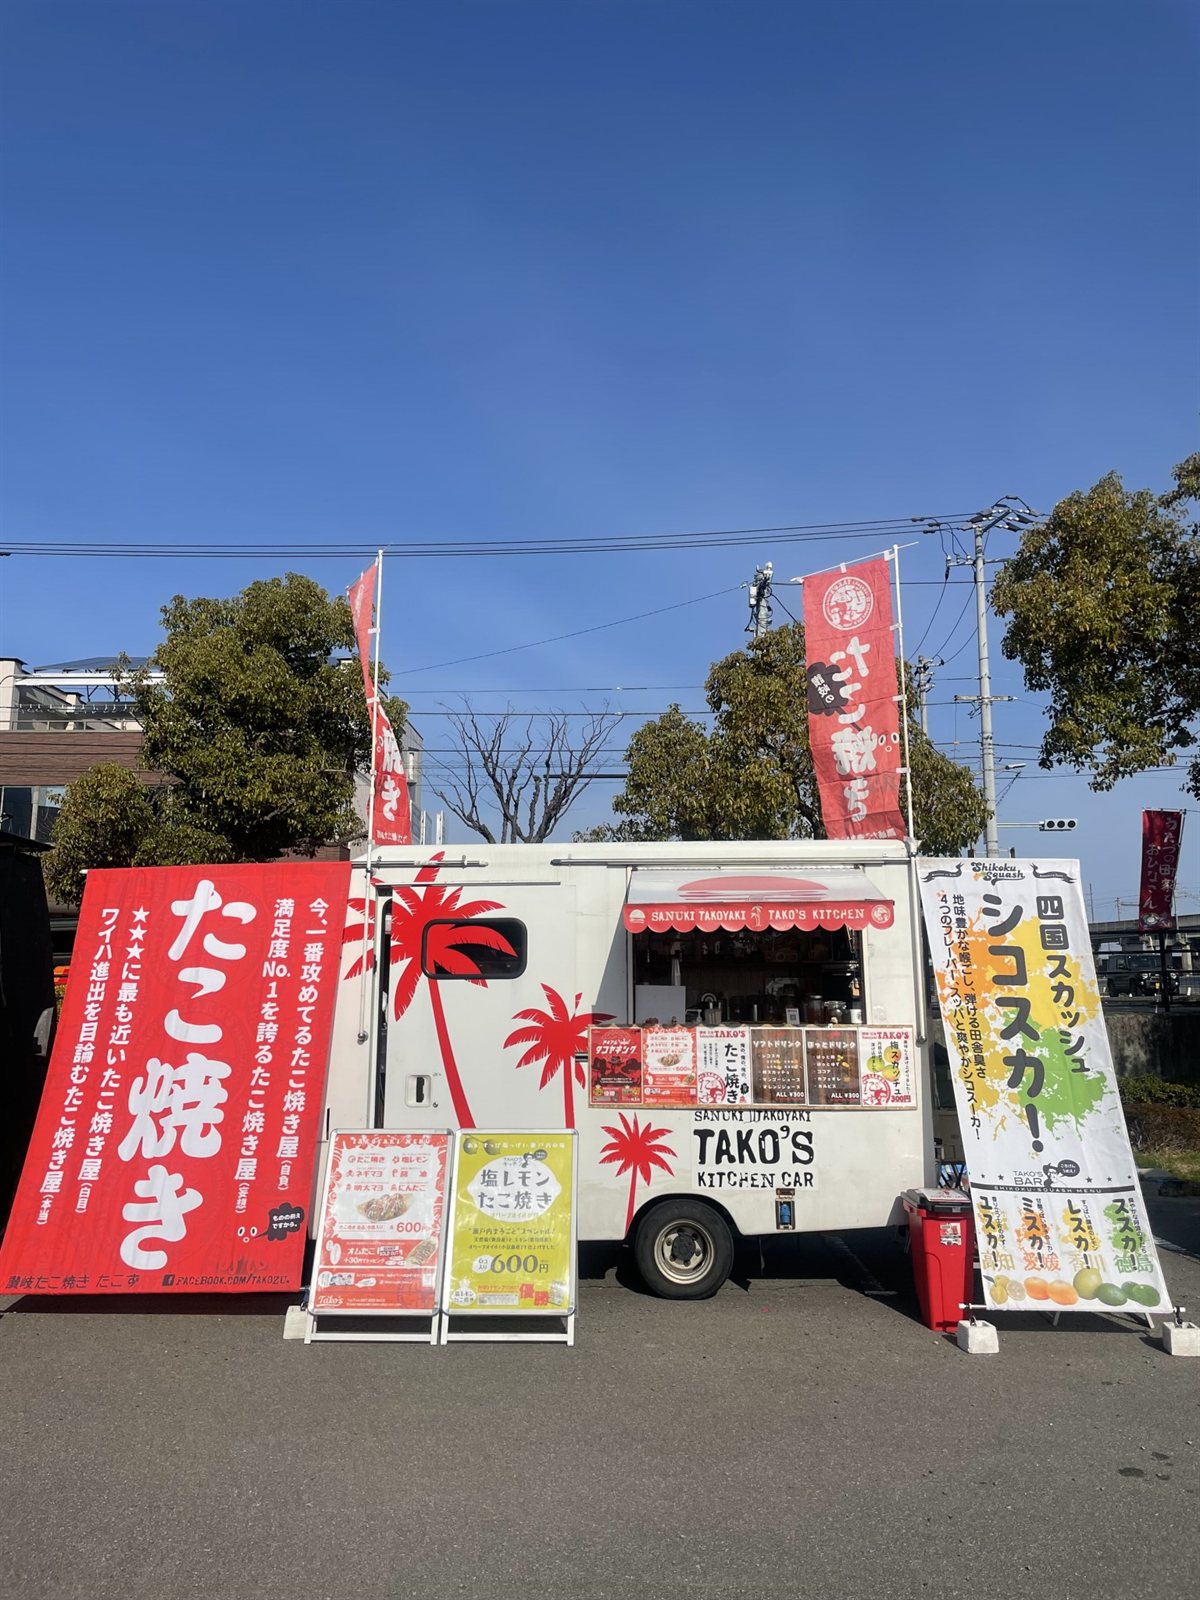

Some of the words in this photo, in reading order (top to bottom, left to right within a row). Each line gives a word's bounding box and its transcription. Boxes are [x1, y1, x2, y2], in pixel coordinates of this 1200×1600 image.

[971, 862, 1016, 873] Shikoku
[983, 870, 1025, 886] Squash
[652, 911, 695, 922] SANUKI
[699, 911, 746, 921] TAKOYAKI
[769, 909, 807, 920] TAKO'S
[813, 908, 865, 919] KITCHEN
[1036, 895, 1091, 1073] 四国スカッシュ
[981, 892, 1045, 1153] シコスカ！
[595, 1045, 637, 1055] タコヤキング
[118, 879, 256, 1270] たこ焼き
[725, 1043, 739, 1103] たこ焼き
[891, 1095, 911, 1103] 300円
[694, 1110, 744, 1121] SANUKI
[693, 1125, 814, 1165] TAKO'S
[480, 1170, 549, 1187] 塩レモン
[698, 1171, 775, 1188] KITCHEN
[782, 1171, 814, 1187] CAR
[1014, 1177, 1042, 1186] BAR
[478, 1191, 552, 1209] たこ焼き
[979, 1196, 999, 1268] ユスカ！
[1021, 1197, 1045, 1269] ミスカ！
[1066, 1198, 1091, 1269] レスカ！
[1112, 1198, 1137, 1271] ススカ！
